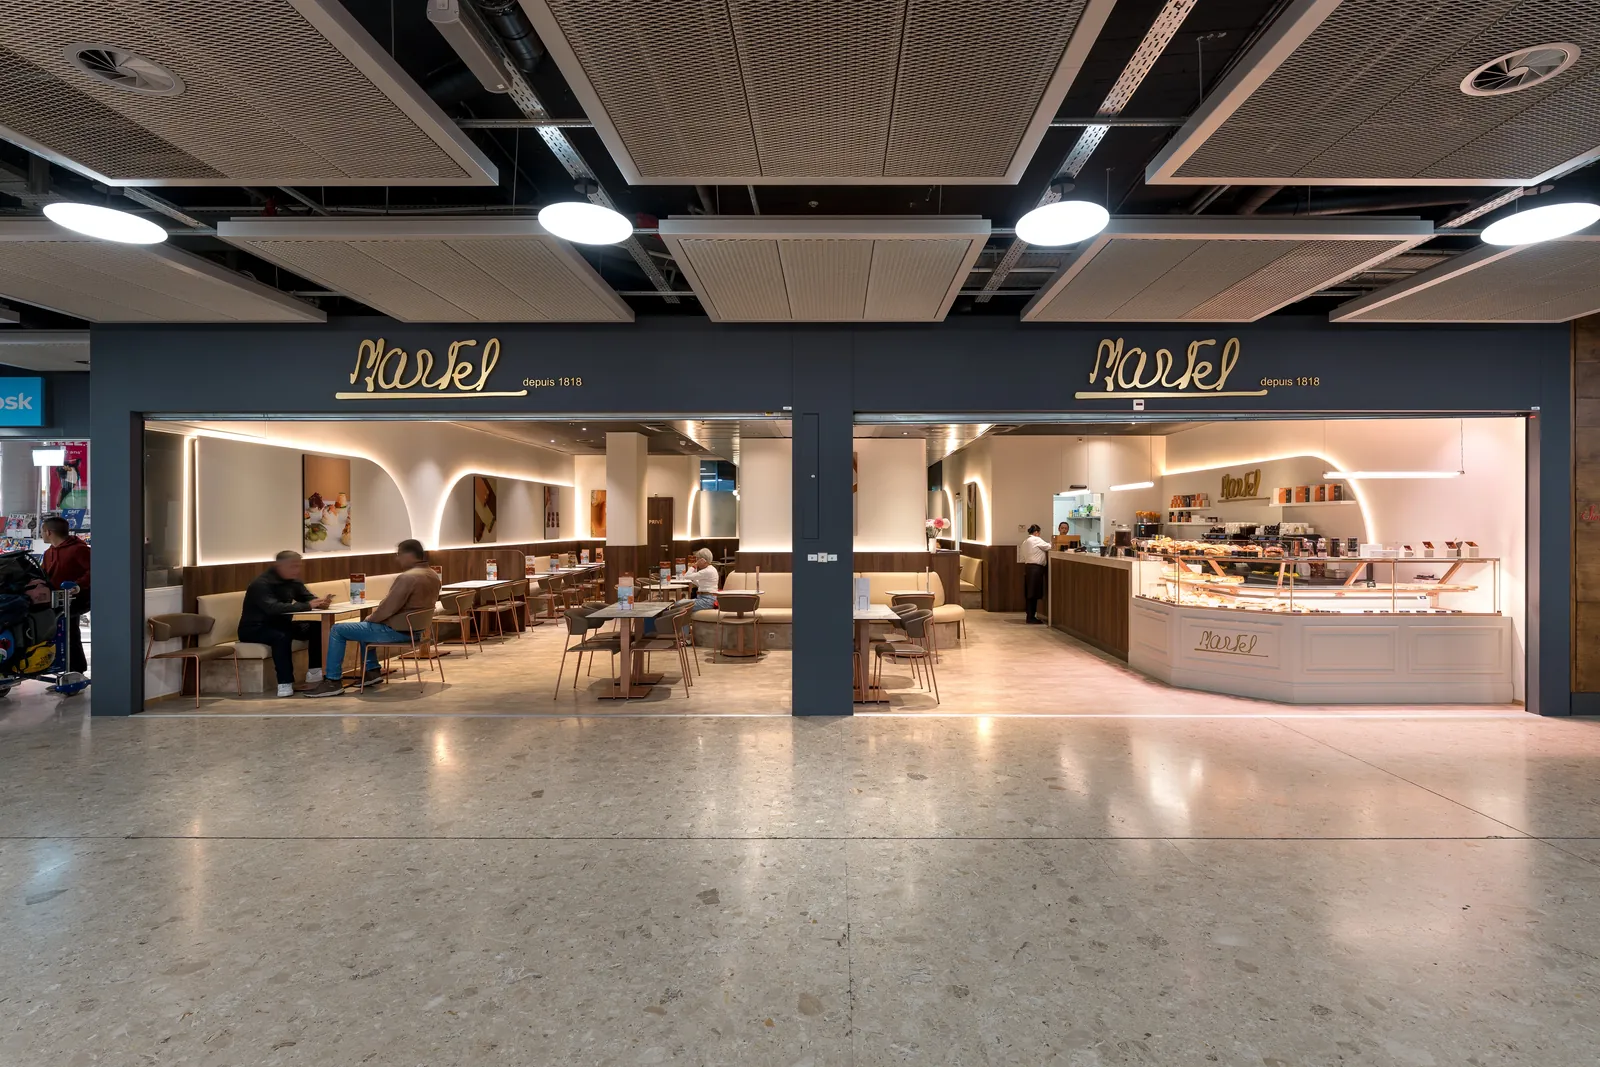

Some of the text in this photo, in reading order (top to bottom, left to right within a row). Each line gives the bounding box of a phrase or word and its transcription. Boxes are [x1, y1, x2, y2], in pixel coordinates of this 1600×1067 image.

[522, 377, 583, 388] depuis 1818
[1260, 377, 1320, 388] depuis 1818
